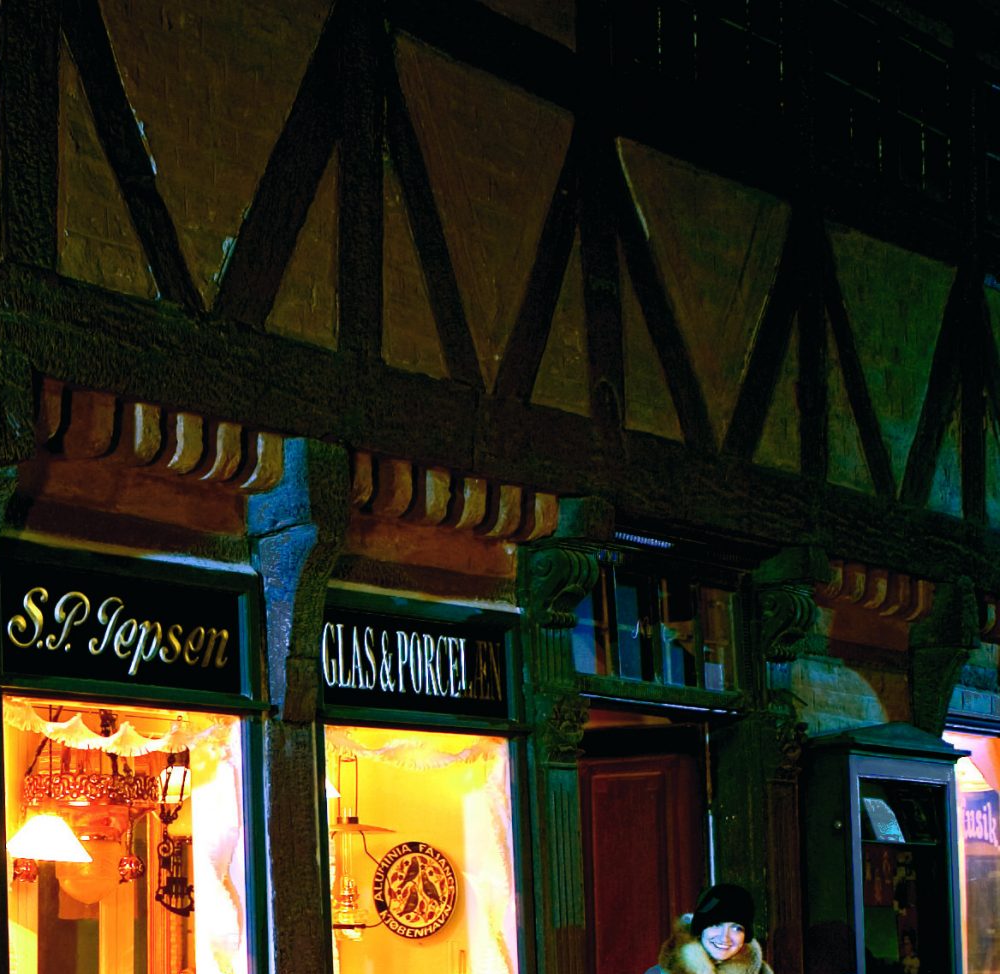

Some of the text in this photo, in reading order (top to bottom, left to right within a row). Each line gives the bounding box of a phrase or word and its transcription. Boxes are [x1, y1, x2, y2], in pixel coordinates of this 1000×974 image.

[88, 596, 229, 676] Jepsen
[321, 622, 376, 690] GLAS
[379, 630, 395, 693] &
[374, 844, 412, 902] ALUMINIA
[380, 904, 452, 938] KJØBENHAVN
